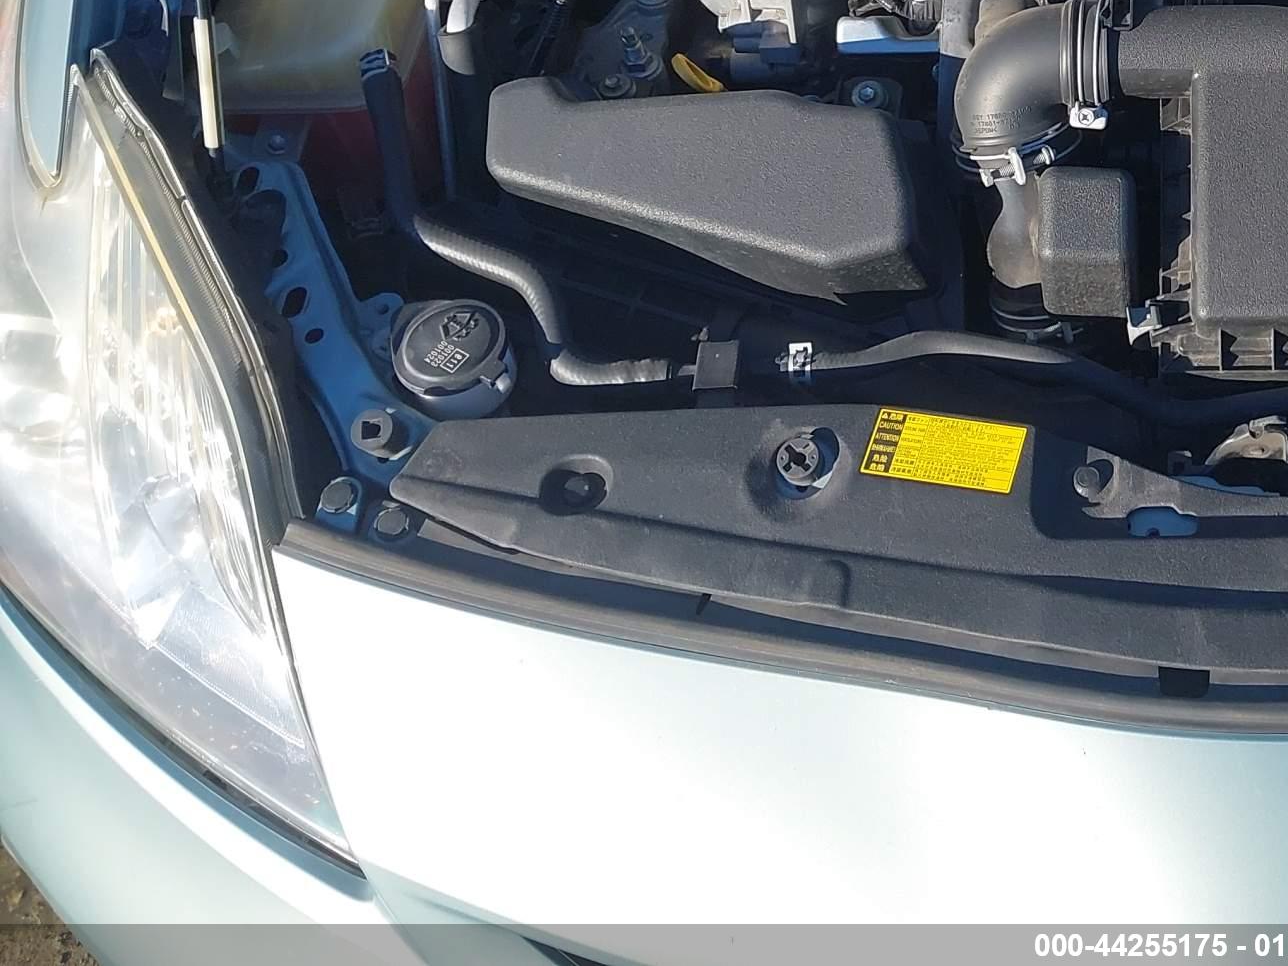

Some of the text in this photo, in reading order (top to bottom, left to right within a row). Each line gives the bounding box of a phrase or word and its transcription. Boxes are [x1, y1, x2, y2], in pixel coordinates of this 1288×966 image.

[424, 340, 448, 363] 001024
[446, 353, 463, 368] e11
[879, 421, 904, 431] CAUTION
[875, 432, 900, 442] ATTENTION
